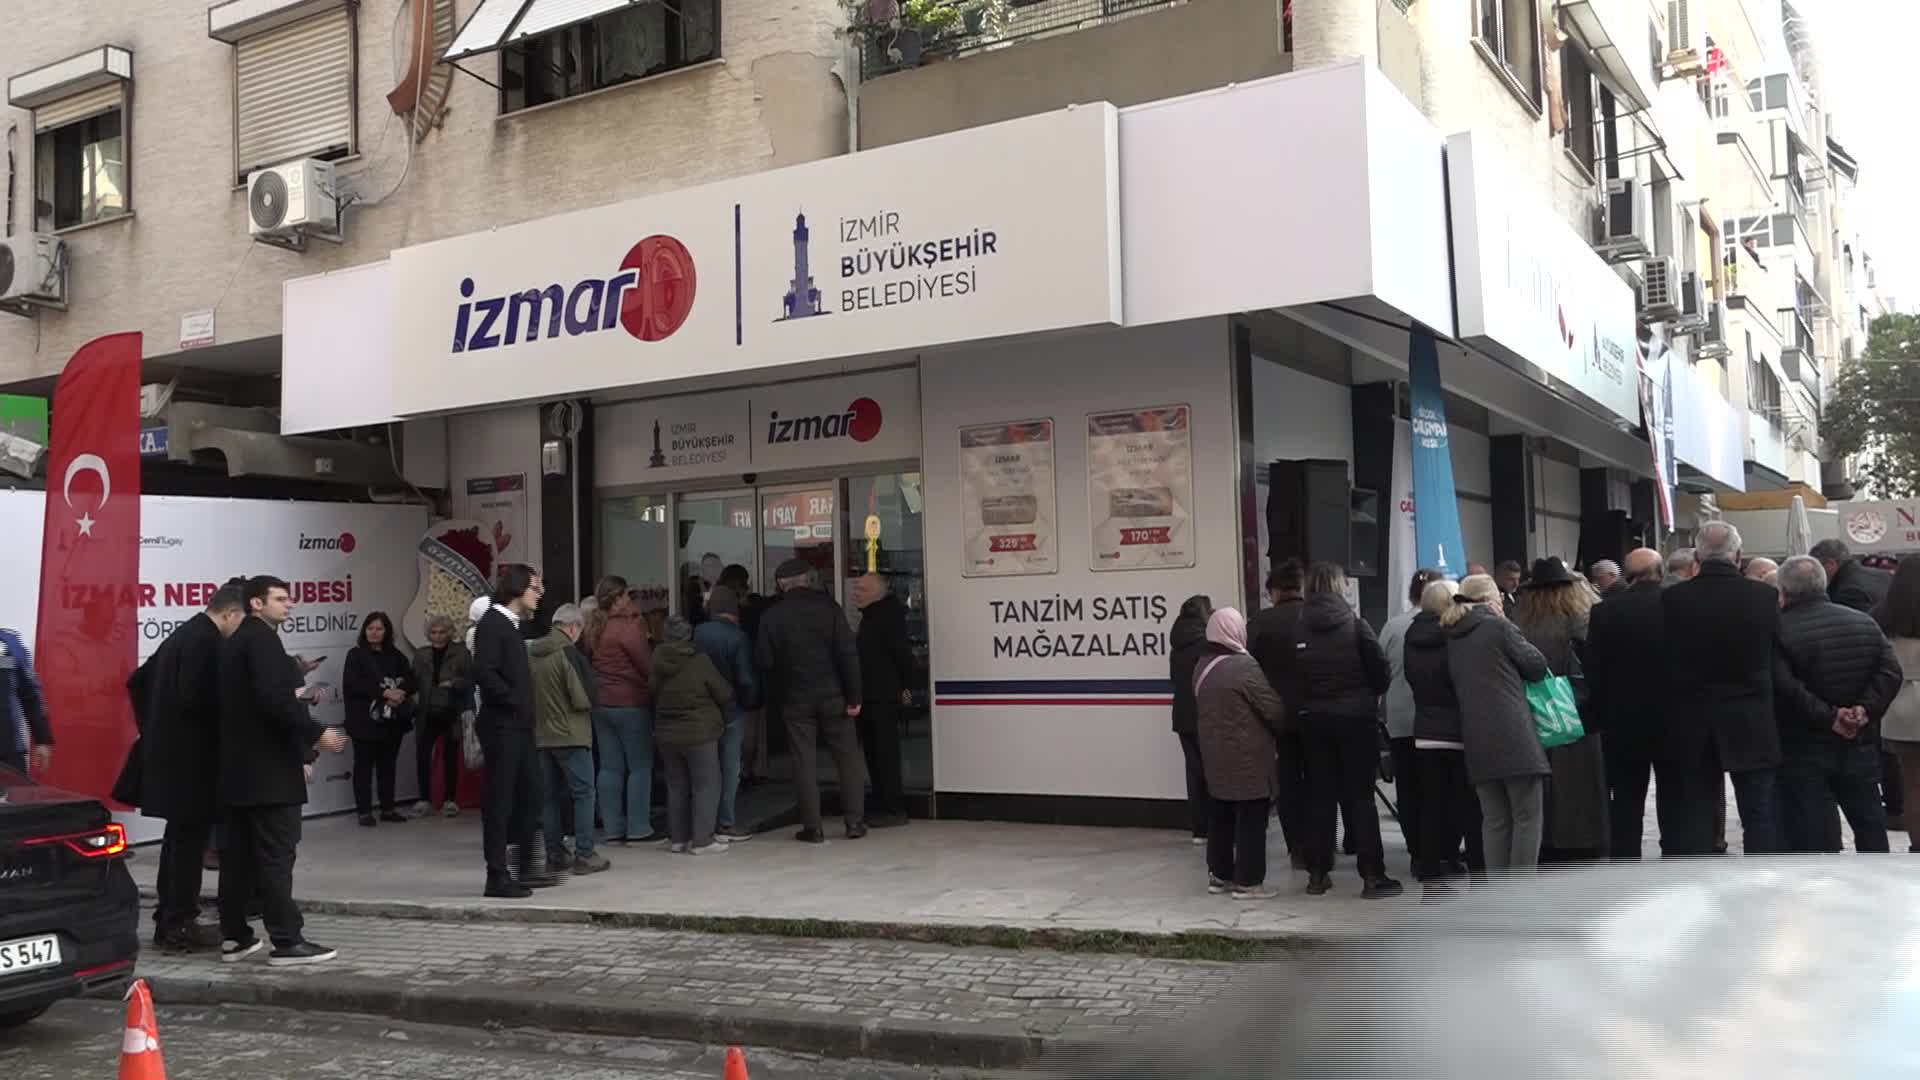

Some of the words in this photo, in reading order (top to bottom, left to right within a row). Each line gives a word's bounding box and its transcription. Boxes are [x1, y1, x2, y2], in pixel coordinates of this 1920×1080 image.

[840, 209, 900, 243] İZMİR
[840, 227, 998, 279] BÜYÜKŞEHİR
[841, 264, 977, 312] BELEDİYESİ
[451, 276, 637, 354] izmar
[671, 431, 735, 451] BÜYÜKŞEHİR
[767, 410, 856, 444] izmar
[299, 532, 344, 550] izmar
[286, 574, 353, 605] UBESİ
[281, 611, 359, 634] GELDİNİZ
[989, 593, 1084, 623] TANZİM
[1092, 594, 1168, 624] SATIŞ
[993, 628, 1166, 659] MAĞAZALARI
[18, 939, 54, 966] 547
